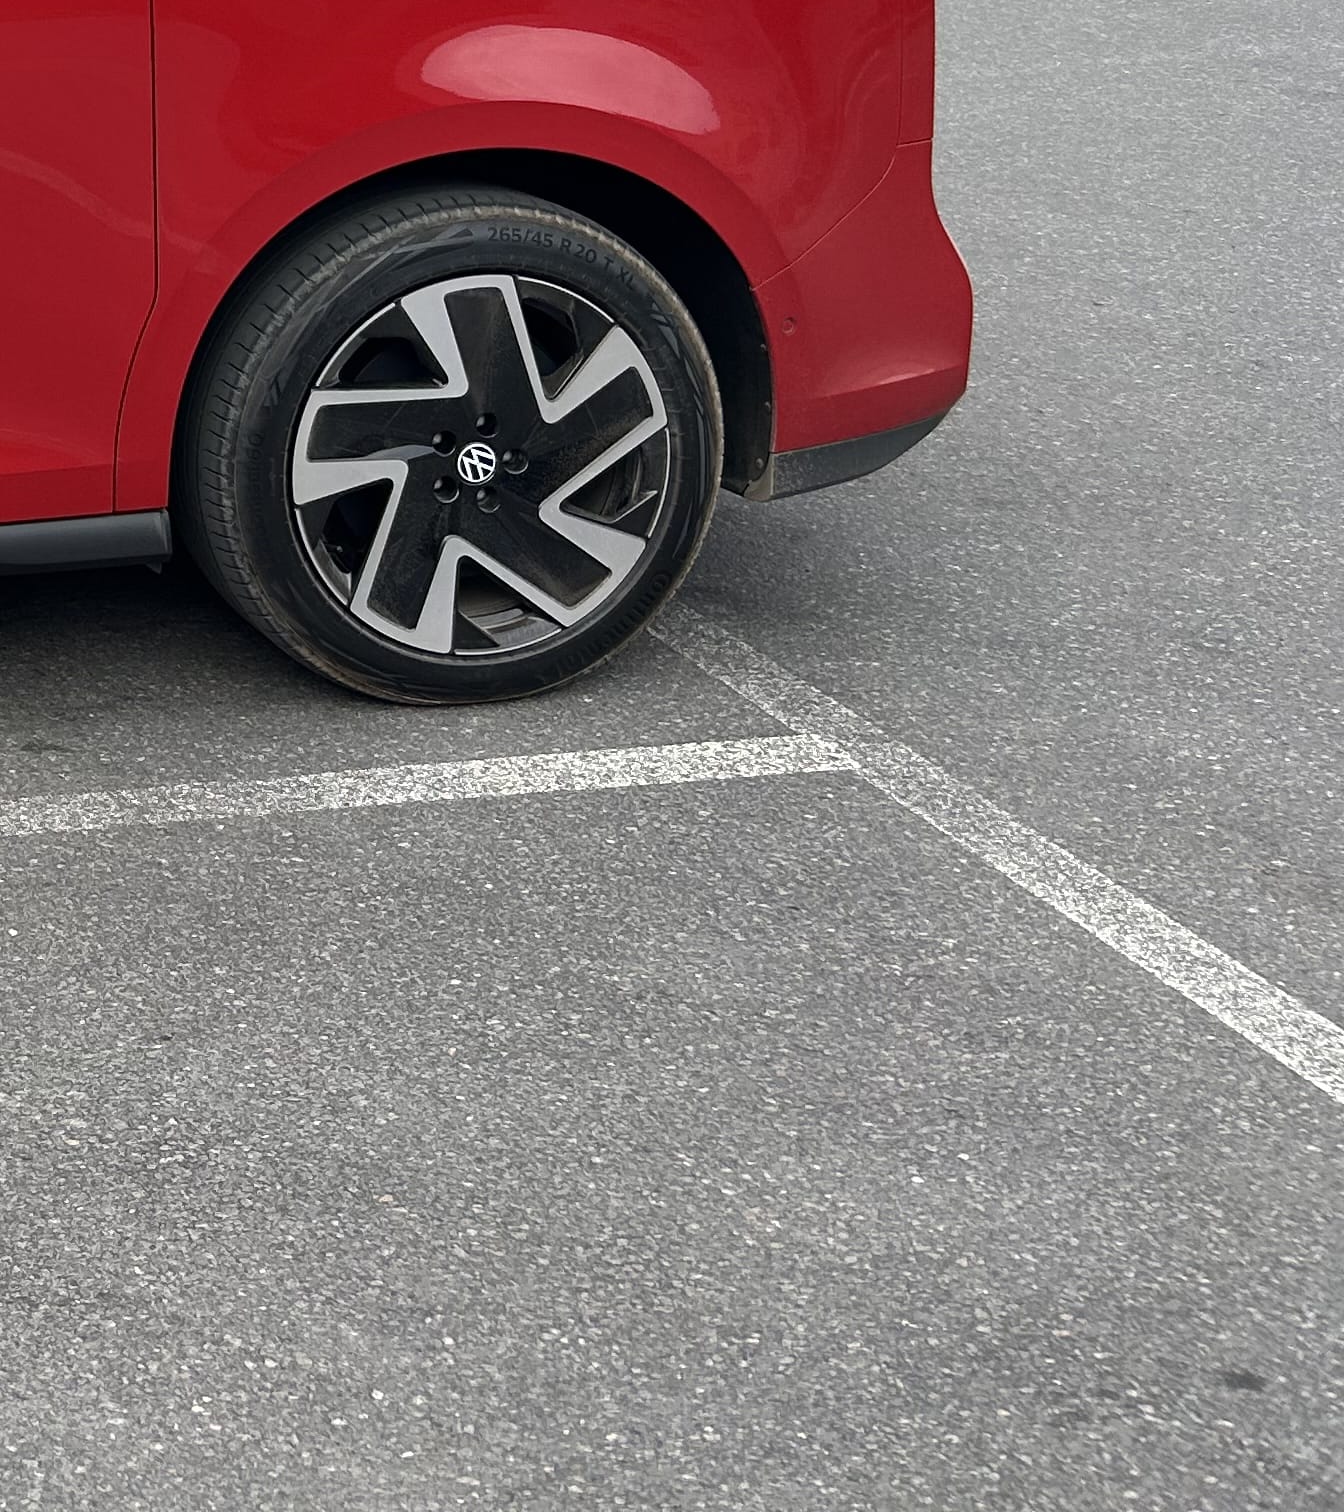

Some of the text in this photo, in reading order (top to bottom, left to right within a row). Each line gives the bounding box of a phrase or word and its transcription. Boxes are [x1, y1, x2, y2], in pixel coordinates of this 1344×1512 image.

[487, 226, 554, 248] 265/45
[602, 256, 615, 271] T
[617, 266, 636, 288] XL
